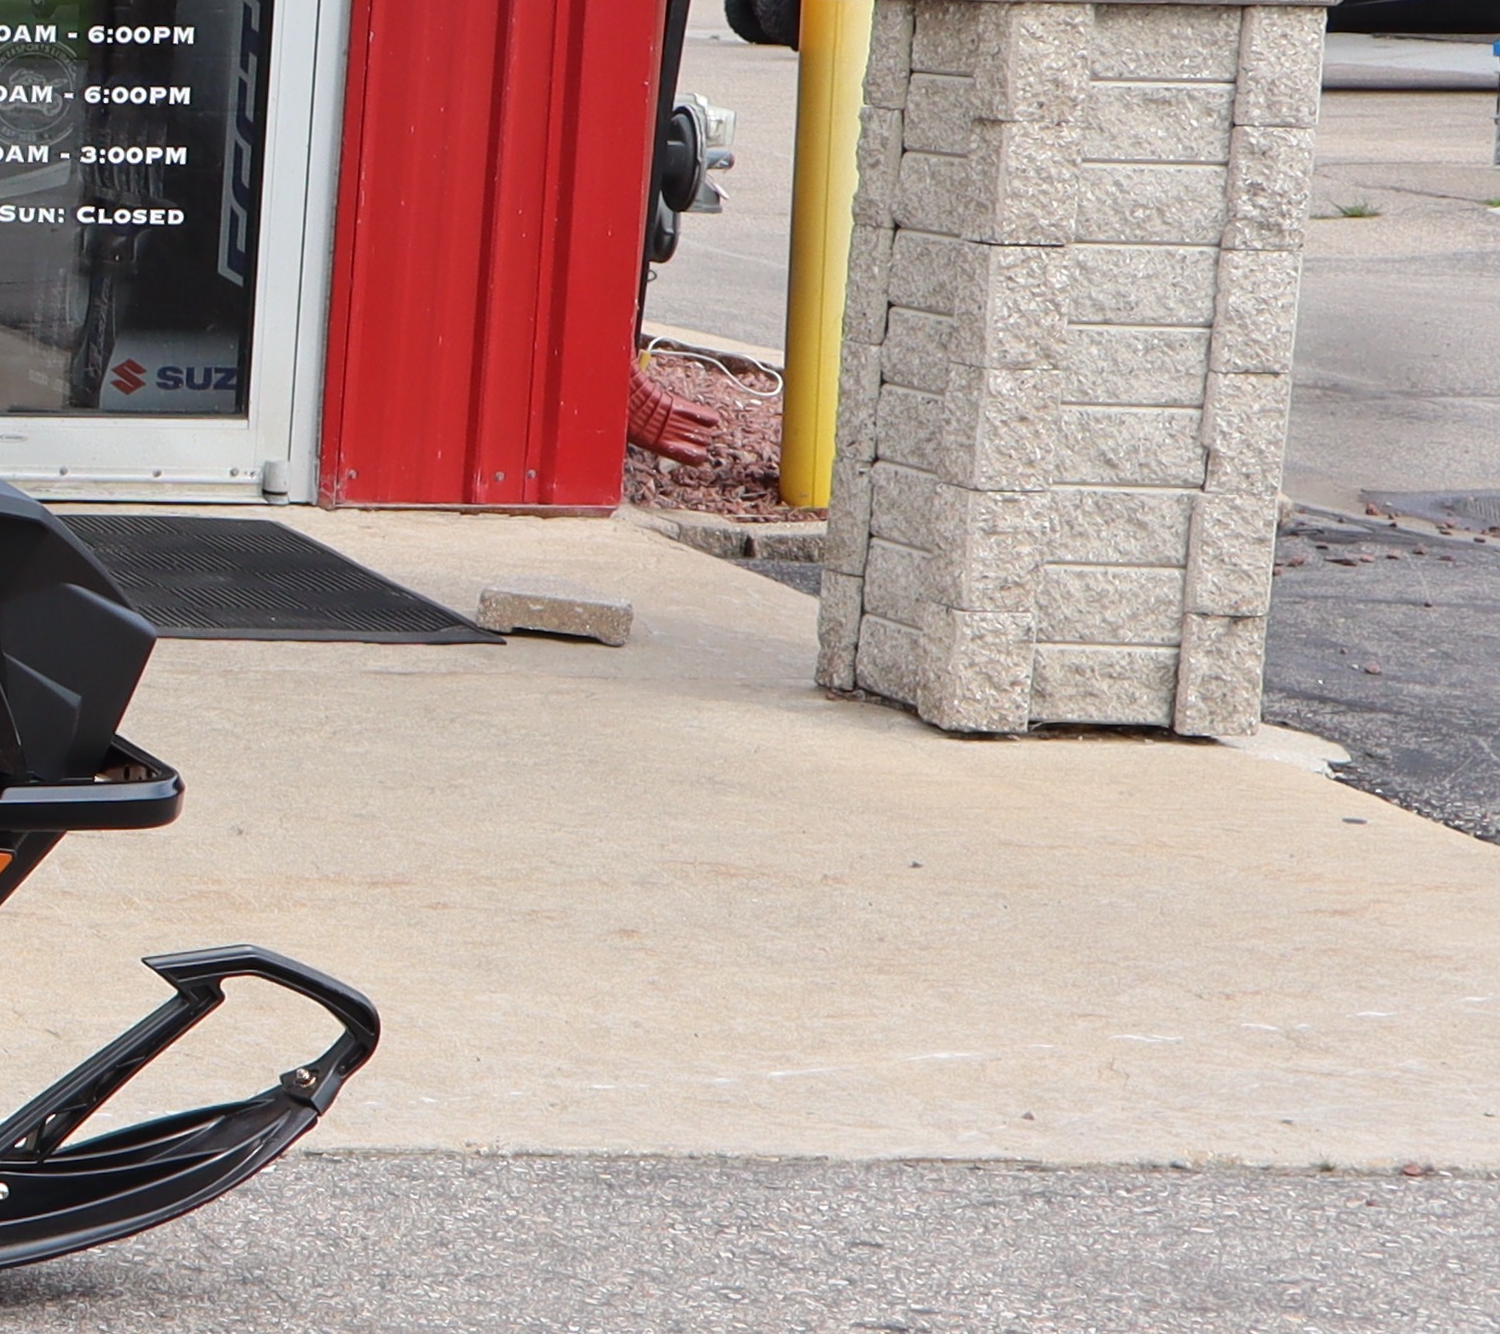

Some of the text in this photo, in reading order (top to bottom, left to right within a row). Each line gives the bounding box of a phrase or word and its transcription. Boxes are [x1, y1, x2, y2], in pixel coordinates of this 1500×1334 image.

[88, 25, 195, 45] 6:00PM
[84, 86, 191, 105] 6:00PM
[79, 146, 187, 165] 3:00PM
